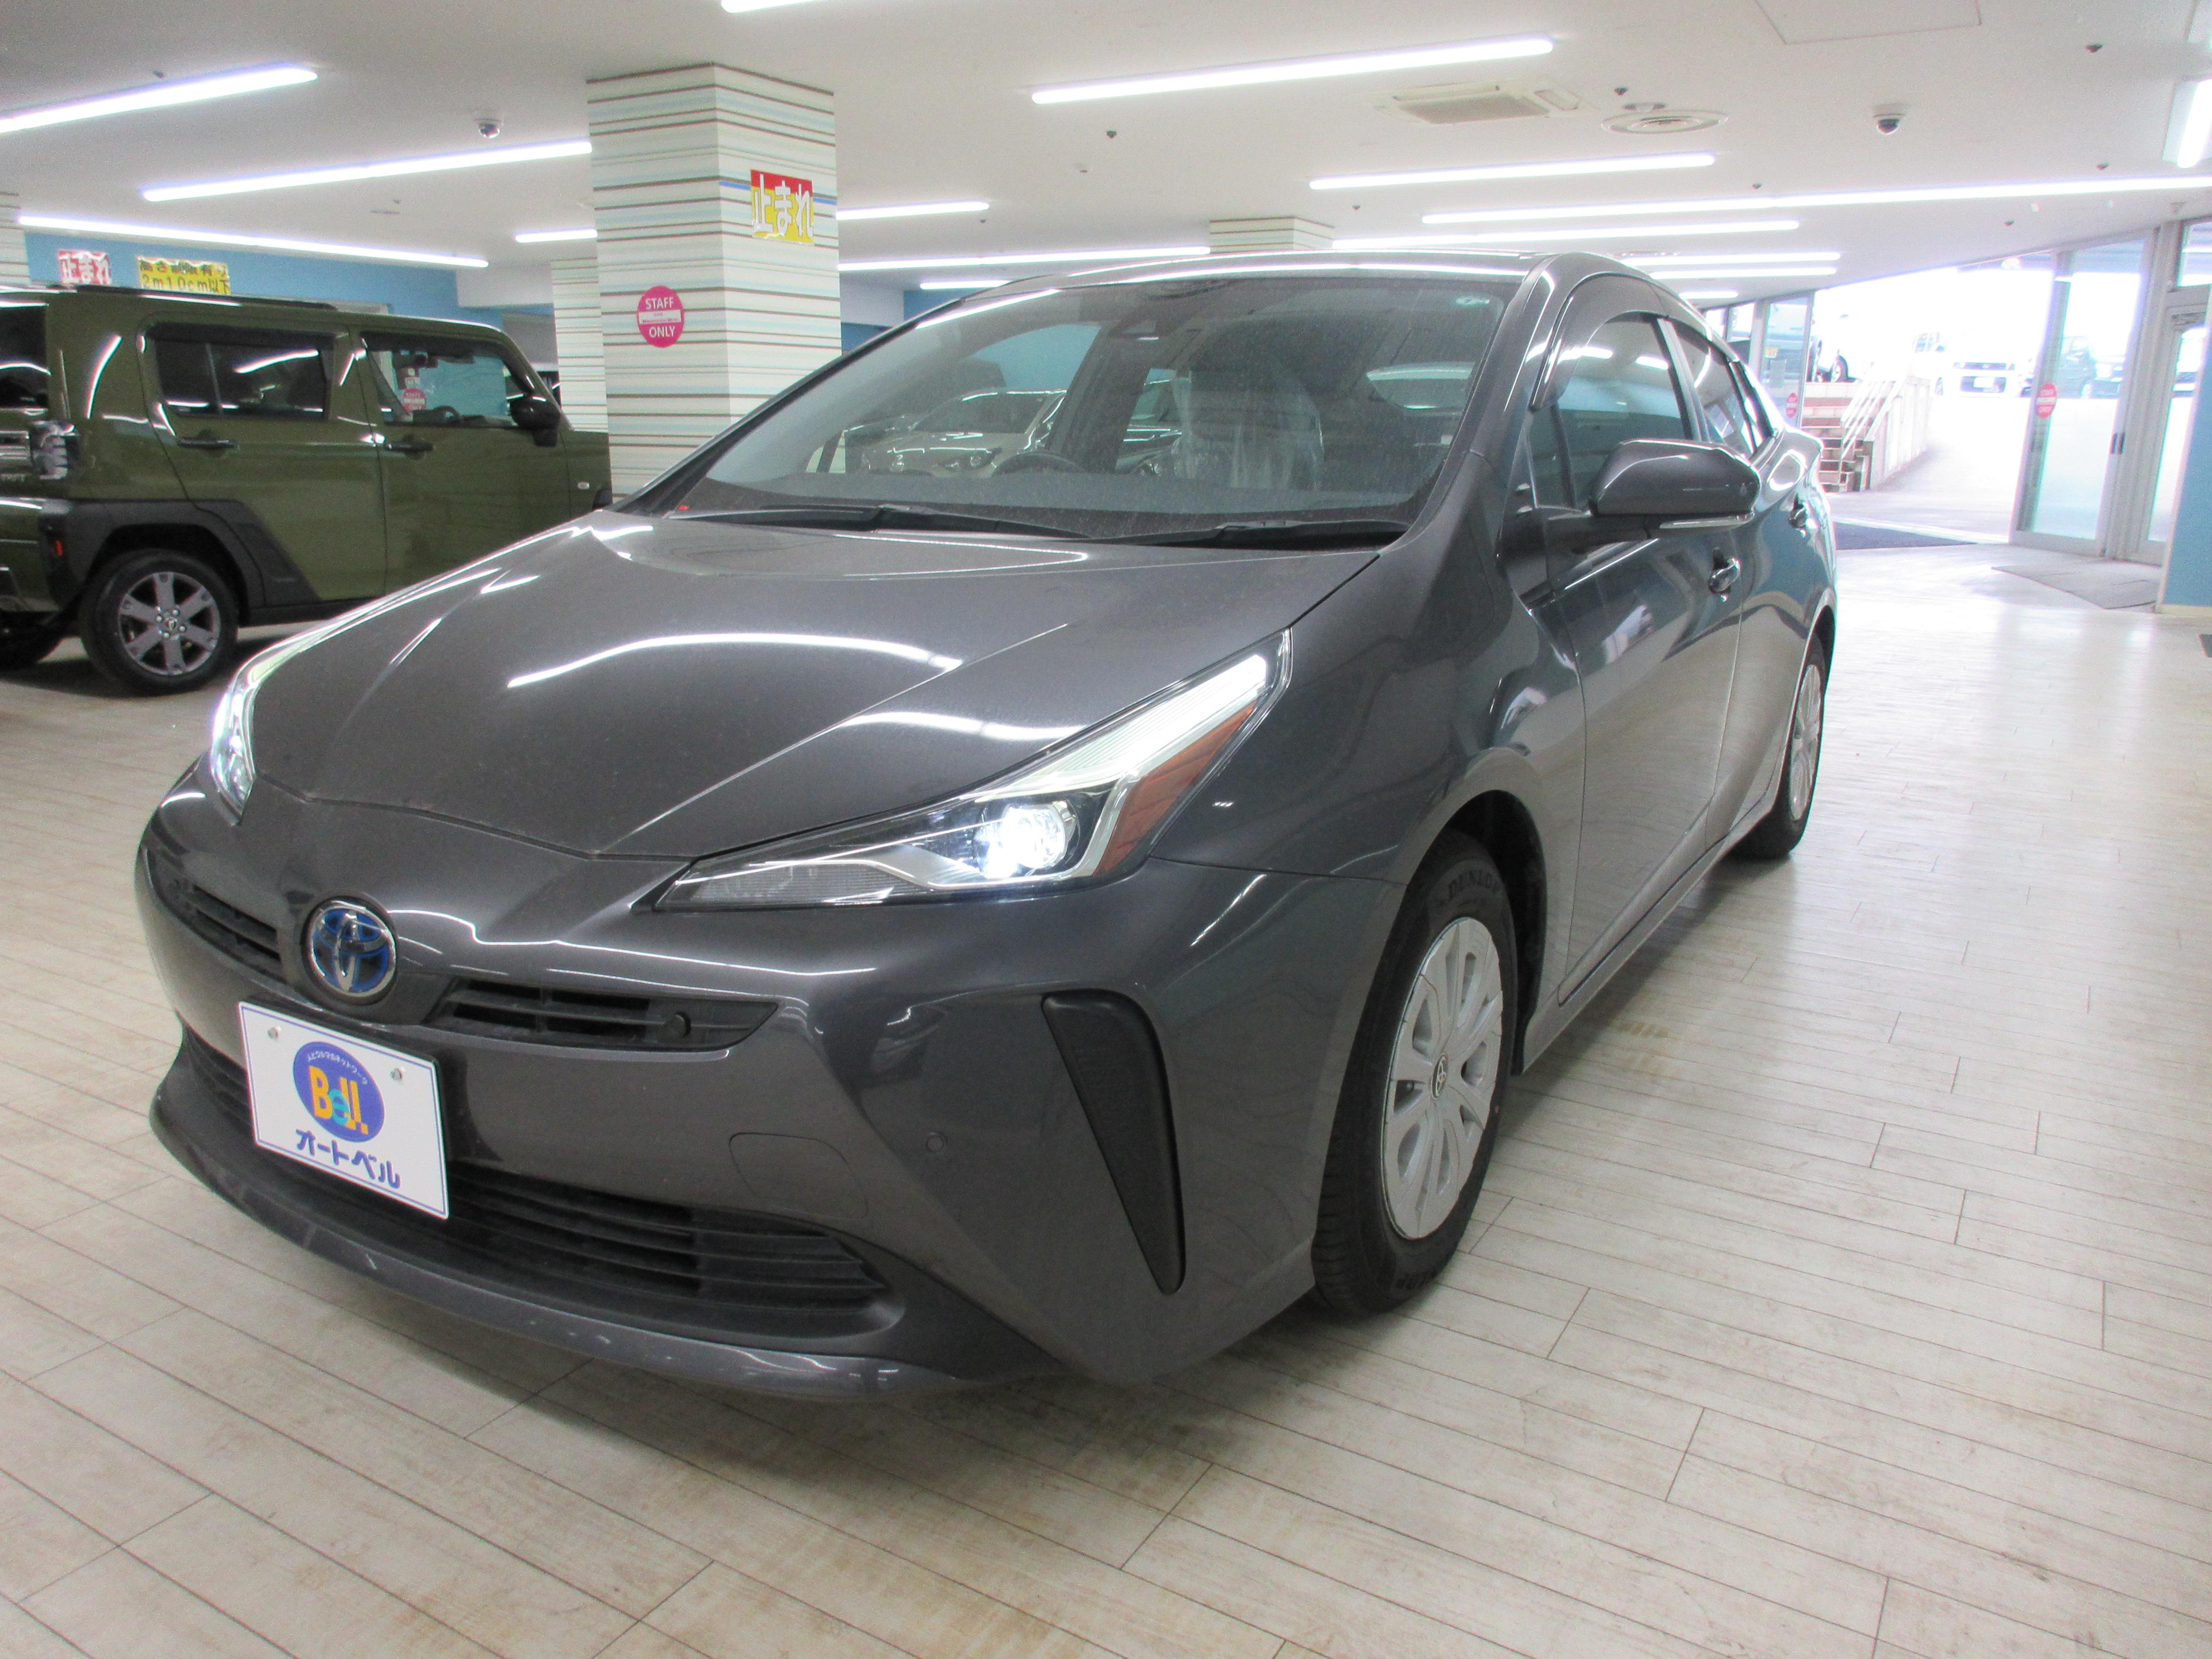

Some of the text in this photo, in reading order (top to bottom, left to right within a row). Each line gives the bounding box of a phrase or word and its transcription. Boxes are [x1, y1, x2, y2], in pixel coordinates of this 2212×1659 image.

[753, 173, 814, 238] 止まれ
[646, 297, 674, 310] STAFF
[649, 325, 675, 338] ONLY
[296, 1129, 401, 1189] オートベル
